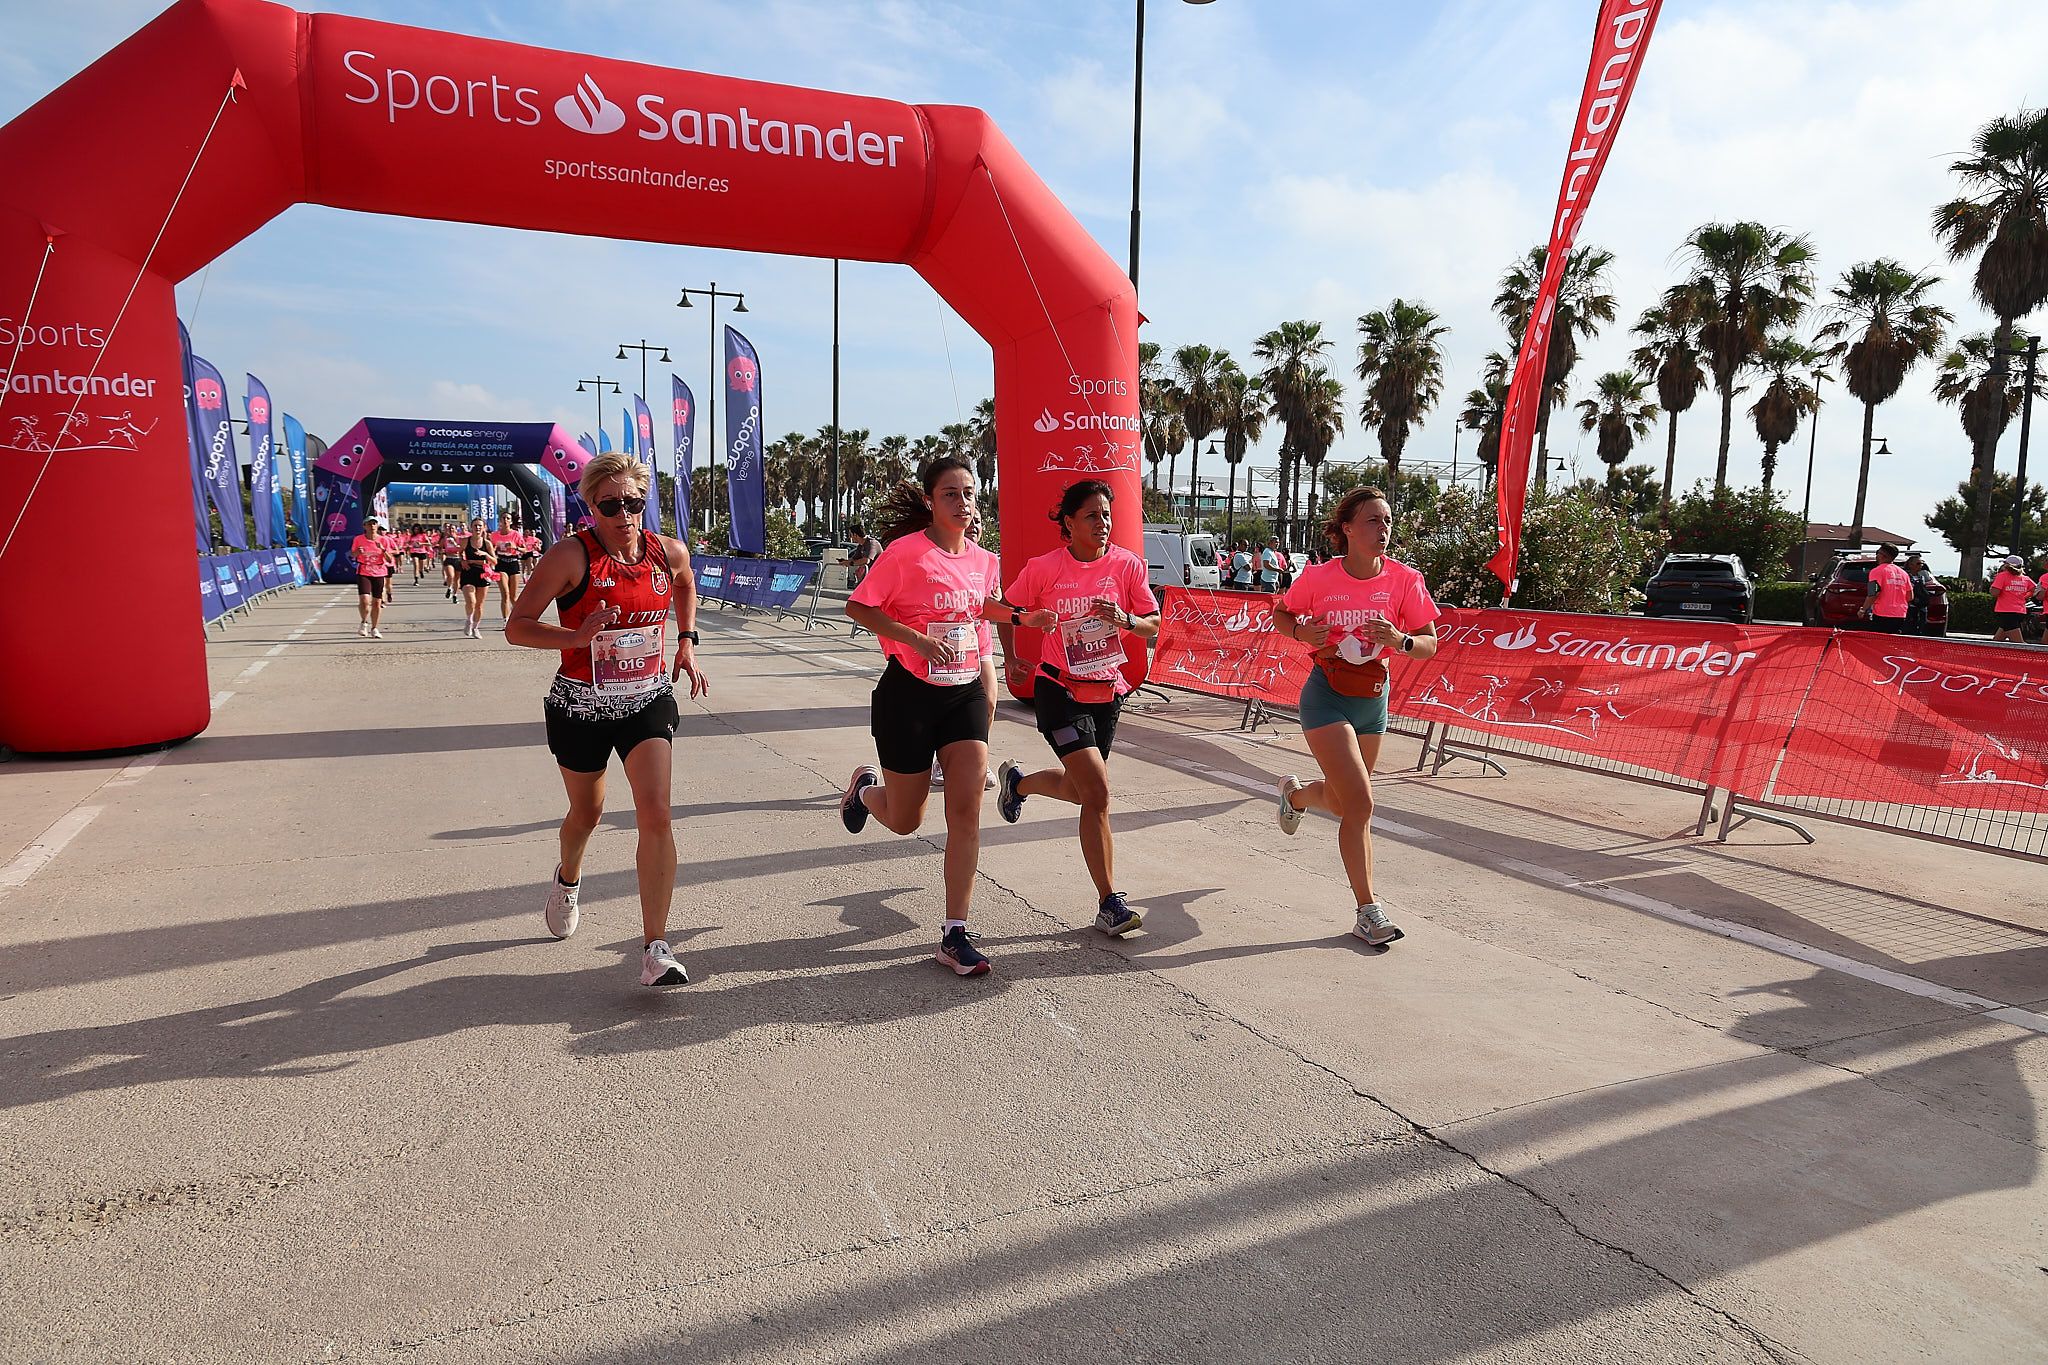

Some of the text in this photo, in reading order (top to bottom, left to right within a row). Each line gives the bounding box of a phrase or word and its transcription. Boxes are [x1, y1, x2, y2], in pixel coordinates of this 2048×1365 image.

[343, 50, 904, 168] Sports Santander
[544, 156, 730, 194] sportssantander.es
[0, 318, 105, 352] Sports
[1069, 374, 1127, 399] Sports
[1063, 411, 1140, 433] Santande
[480, 443, 513, 451] CORRER
[397, 462, 495, 474] VOLVO
[1054, 582, 1079, 590] OYSHO
[1165, 600, 1227, 627] Sports
[1085, 638, 1108, 652] 016
[1435, 623, 1757, 677] orts Santander
[618, 657, 646, 671] 016
[956, 651, 967, 662] 16
